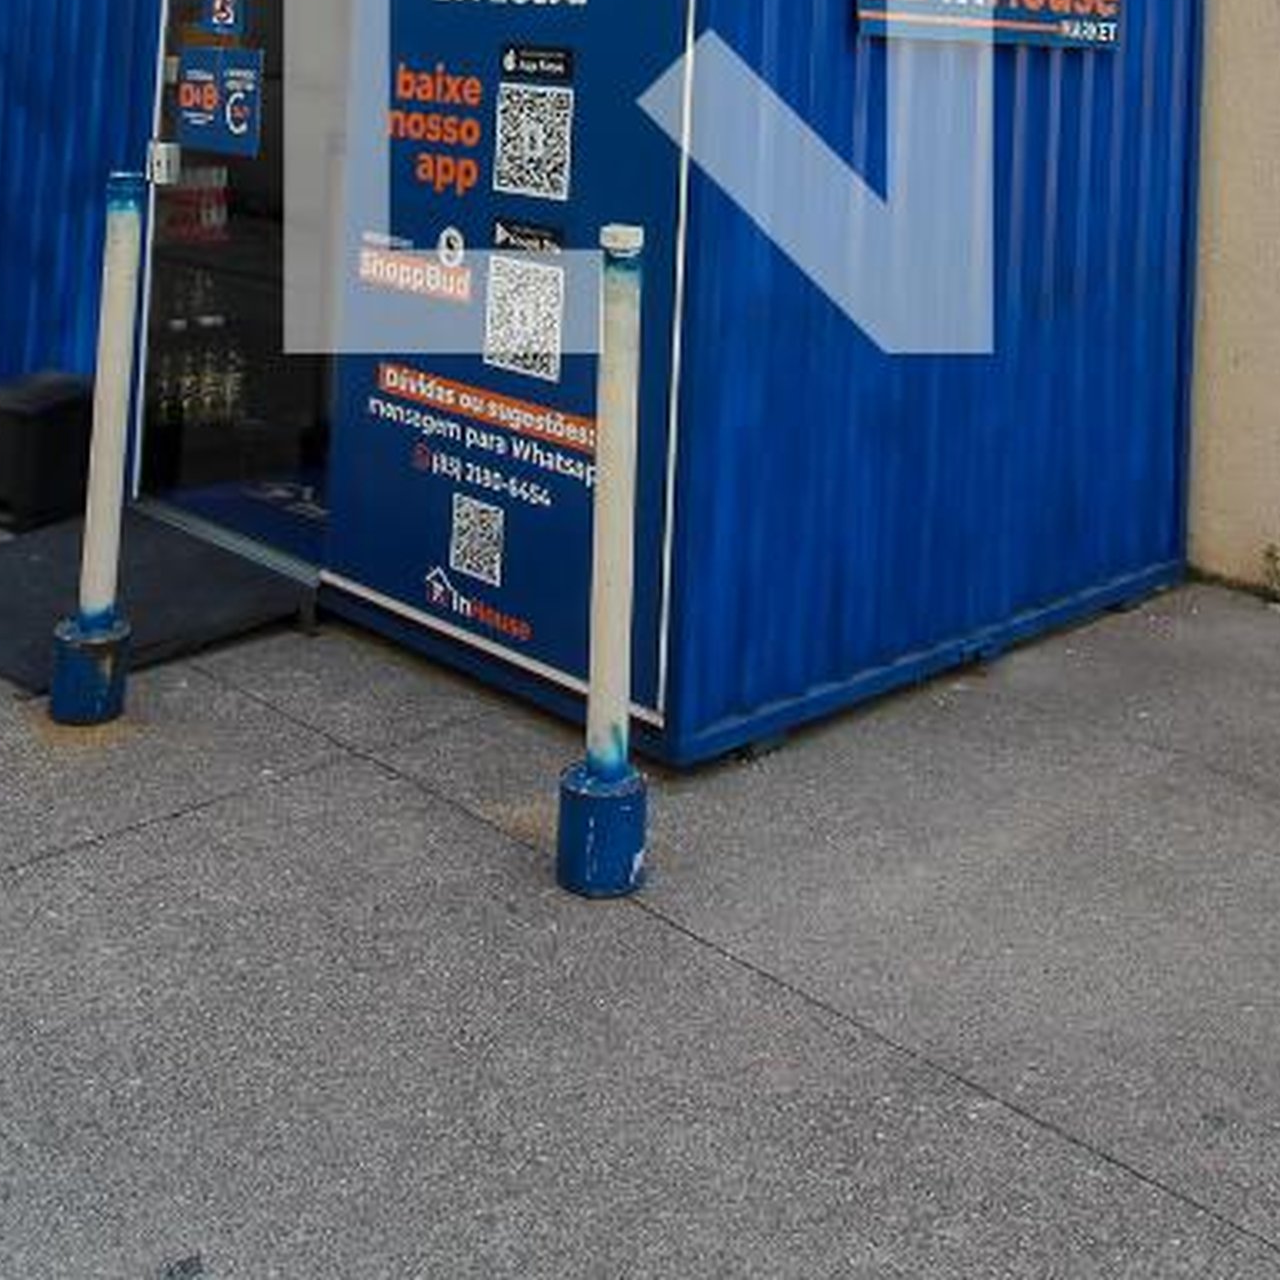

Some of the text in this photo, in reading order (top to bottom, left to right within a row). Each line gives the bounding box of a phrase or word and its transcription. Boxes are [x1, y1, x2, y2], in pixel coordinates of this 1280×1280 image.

[1063, 20, 1118, 43] MARKET
[396, 62, 482, 107] baixe
[385, 109, 481, 147] nosso
[416, 152, 480, 196] app
[459, 392, 484, 412] ou
[486, 399, 596, 447] sugestões:
[465, 427, 508, 455] para
[511, 435, 597, 488] Whatsap
[452, 588, 534, 641] InHouse
